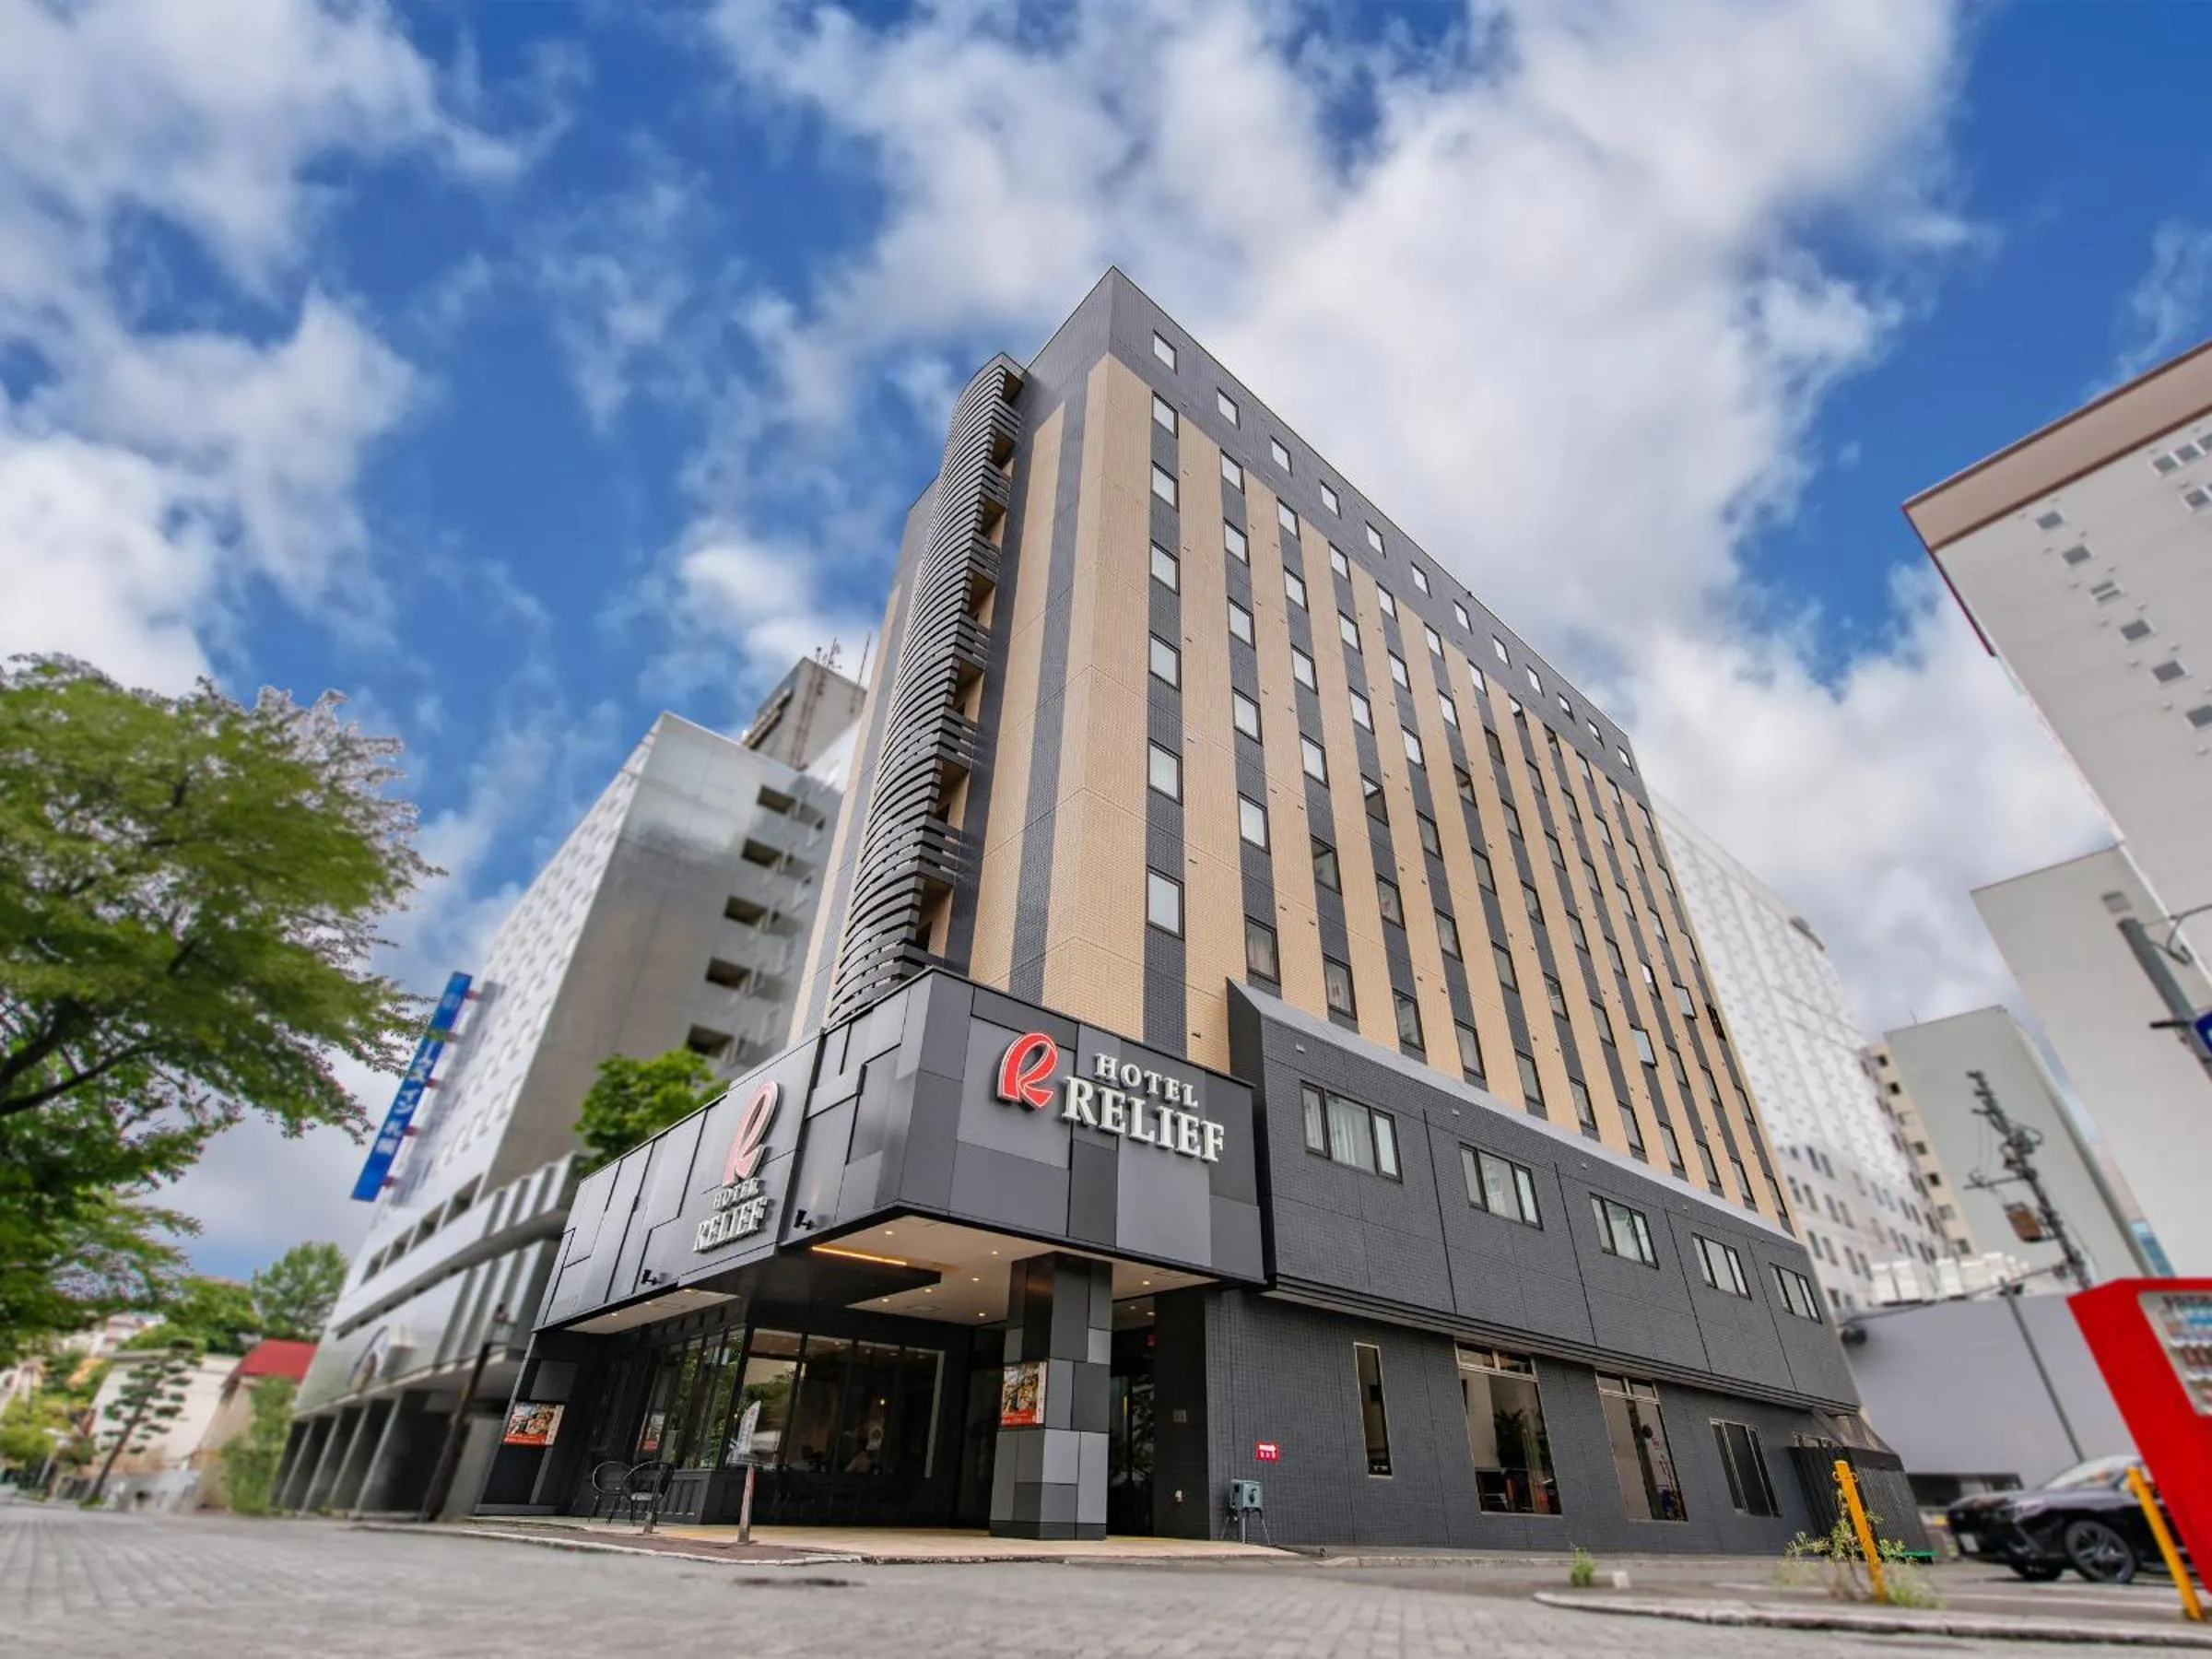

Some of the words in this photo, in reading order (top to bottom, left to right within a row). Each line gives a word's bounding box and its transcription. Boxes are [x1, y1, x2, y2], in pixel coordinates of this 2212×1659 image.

[1095, 1053, 1199, 1108] HOTEL
[1061, 1076, 1226, 1163] RELIEF
[713, 1177, 760, 1212] HOTEL
[693, 1196, 769, 1253] RELIEF
